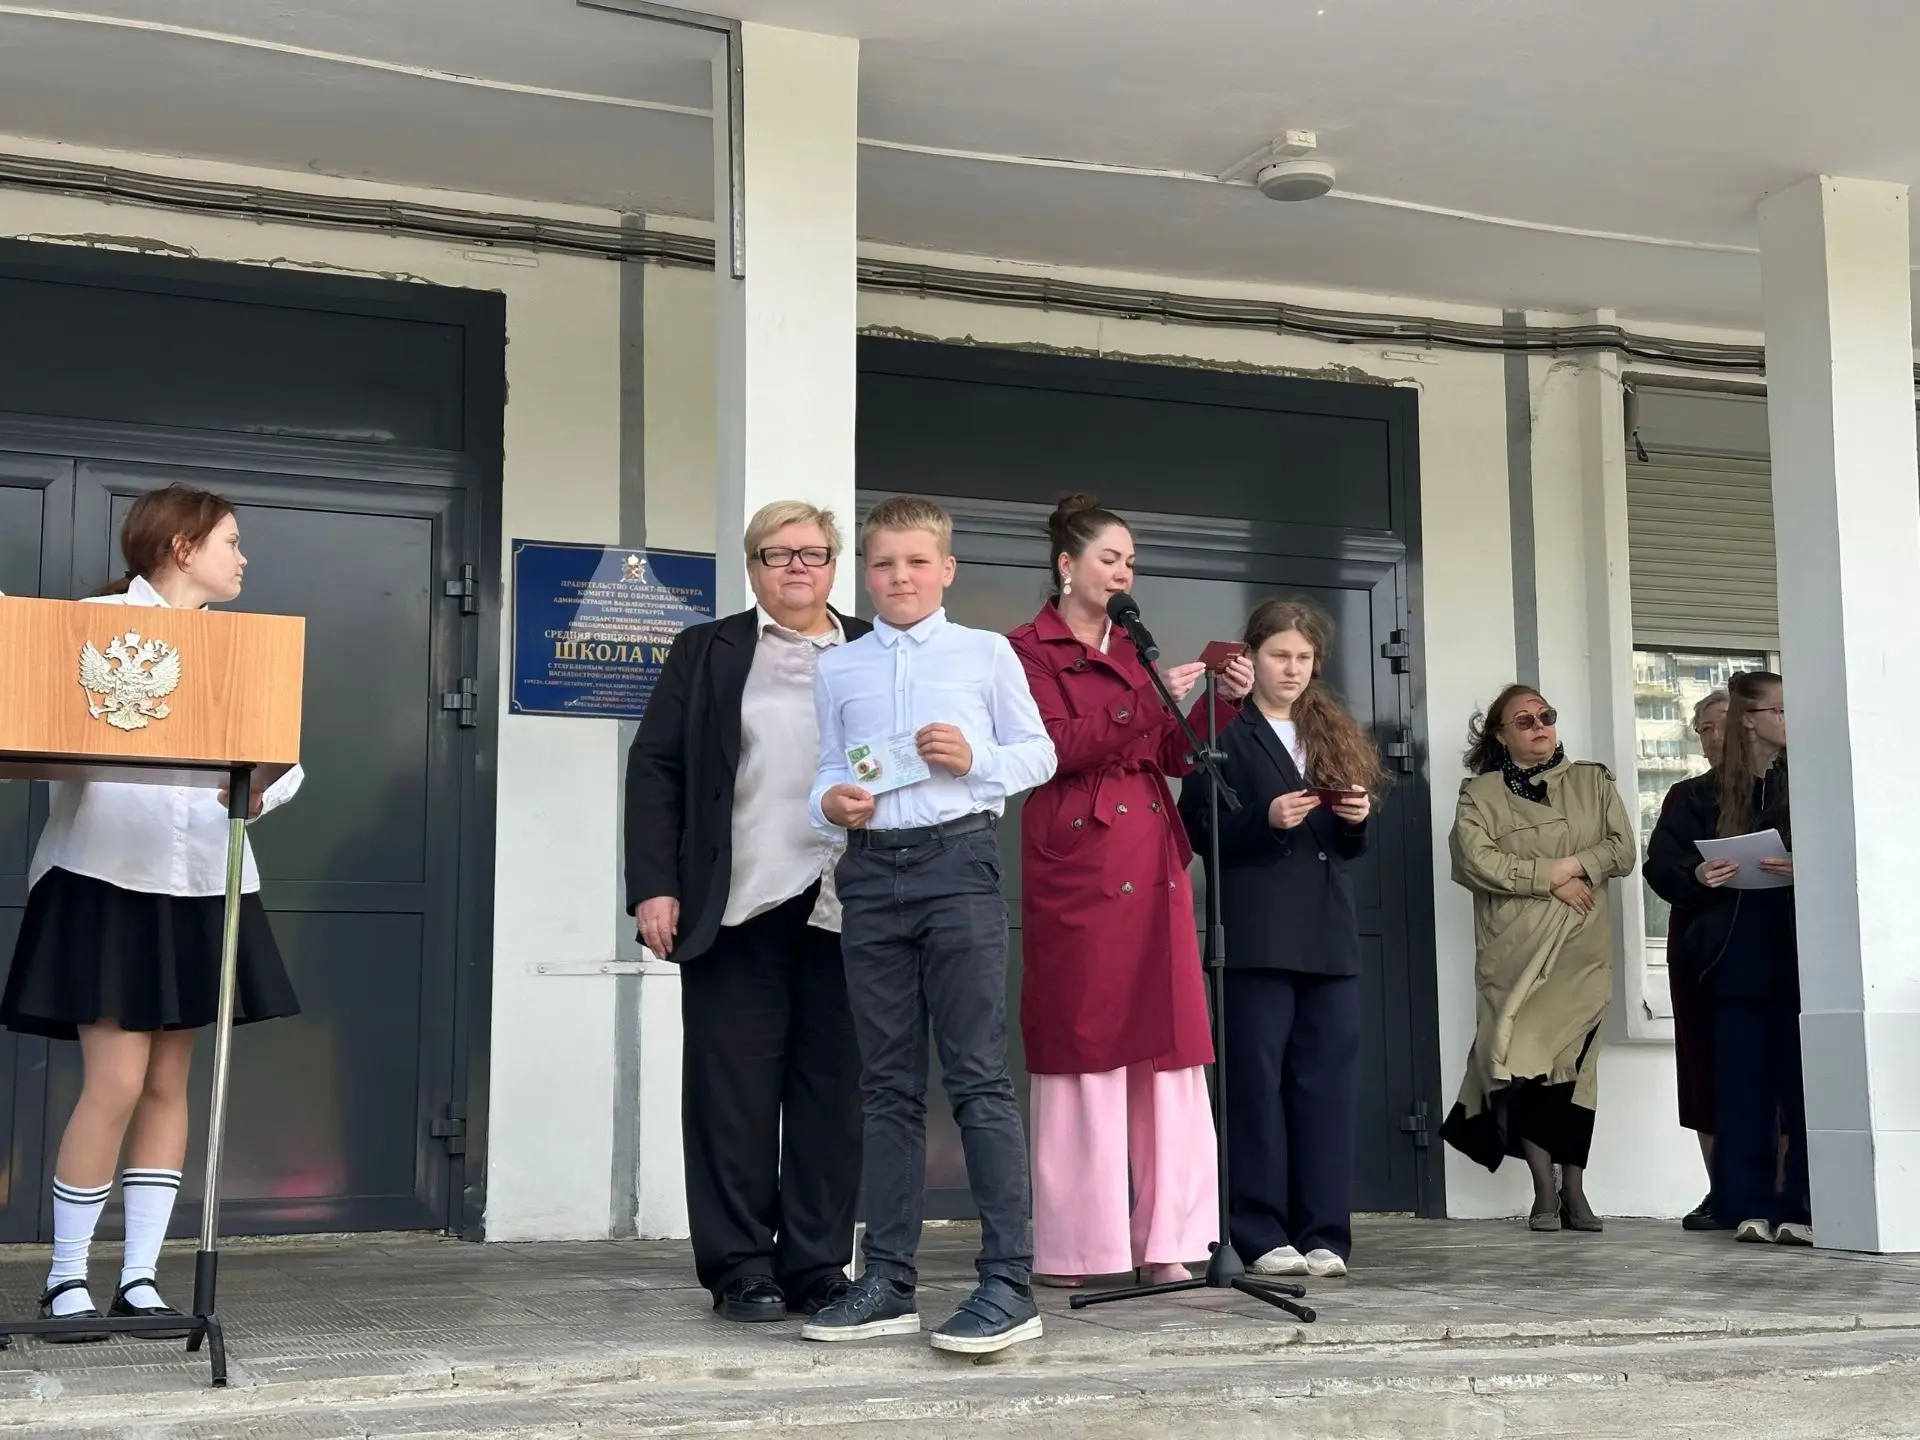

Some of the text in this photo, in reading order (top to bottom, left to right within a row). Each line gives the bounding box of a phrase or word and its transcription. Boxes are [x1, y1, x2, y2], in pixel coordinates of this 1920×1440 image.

[578, 590, 614, 598] КОМИТЕТ
[544, 629, 591, 640] СРЕДНЯЯ
[554, 641, 643, 663] ШКОЛА
